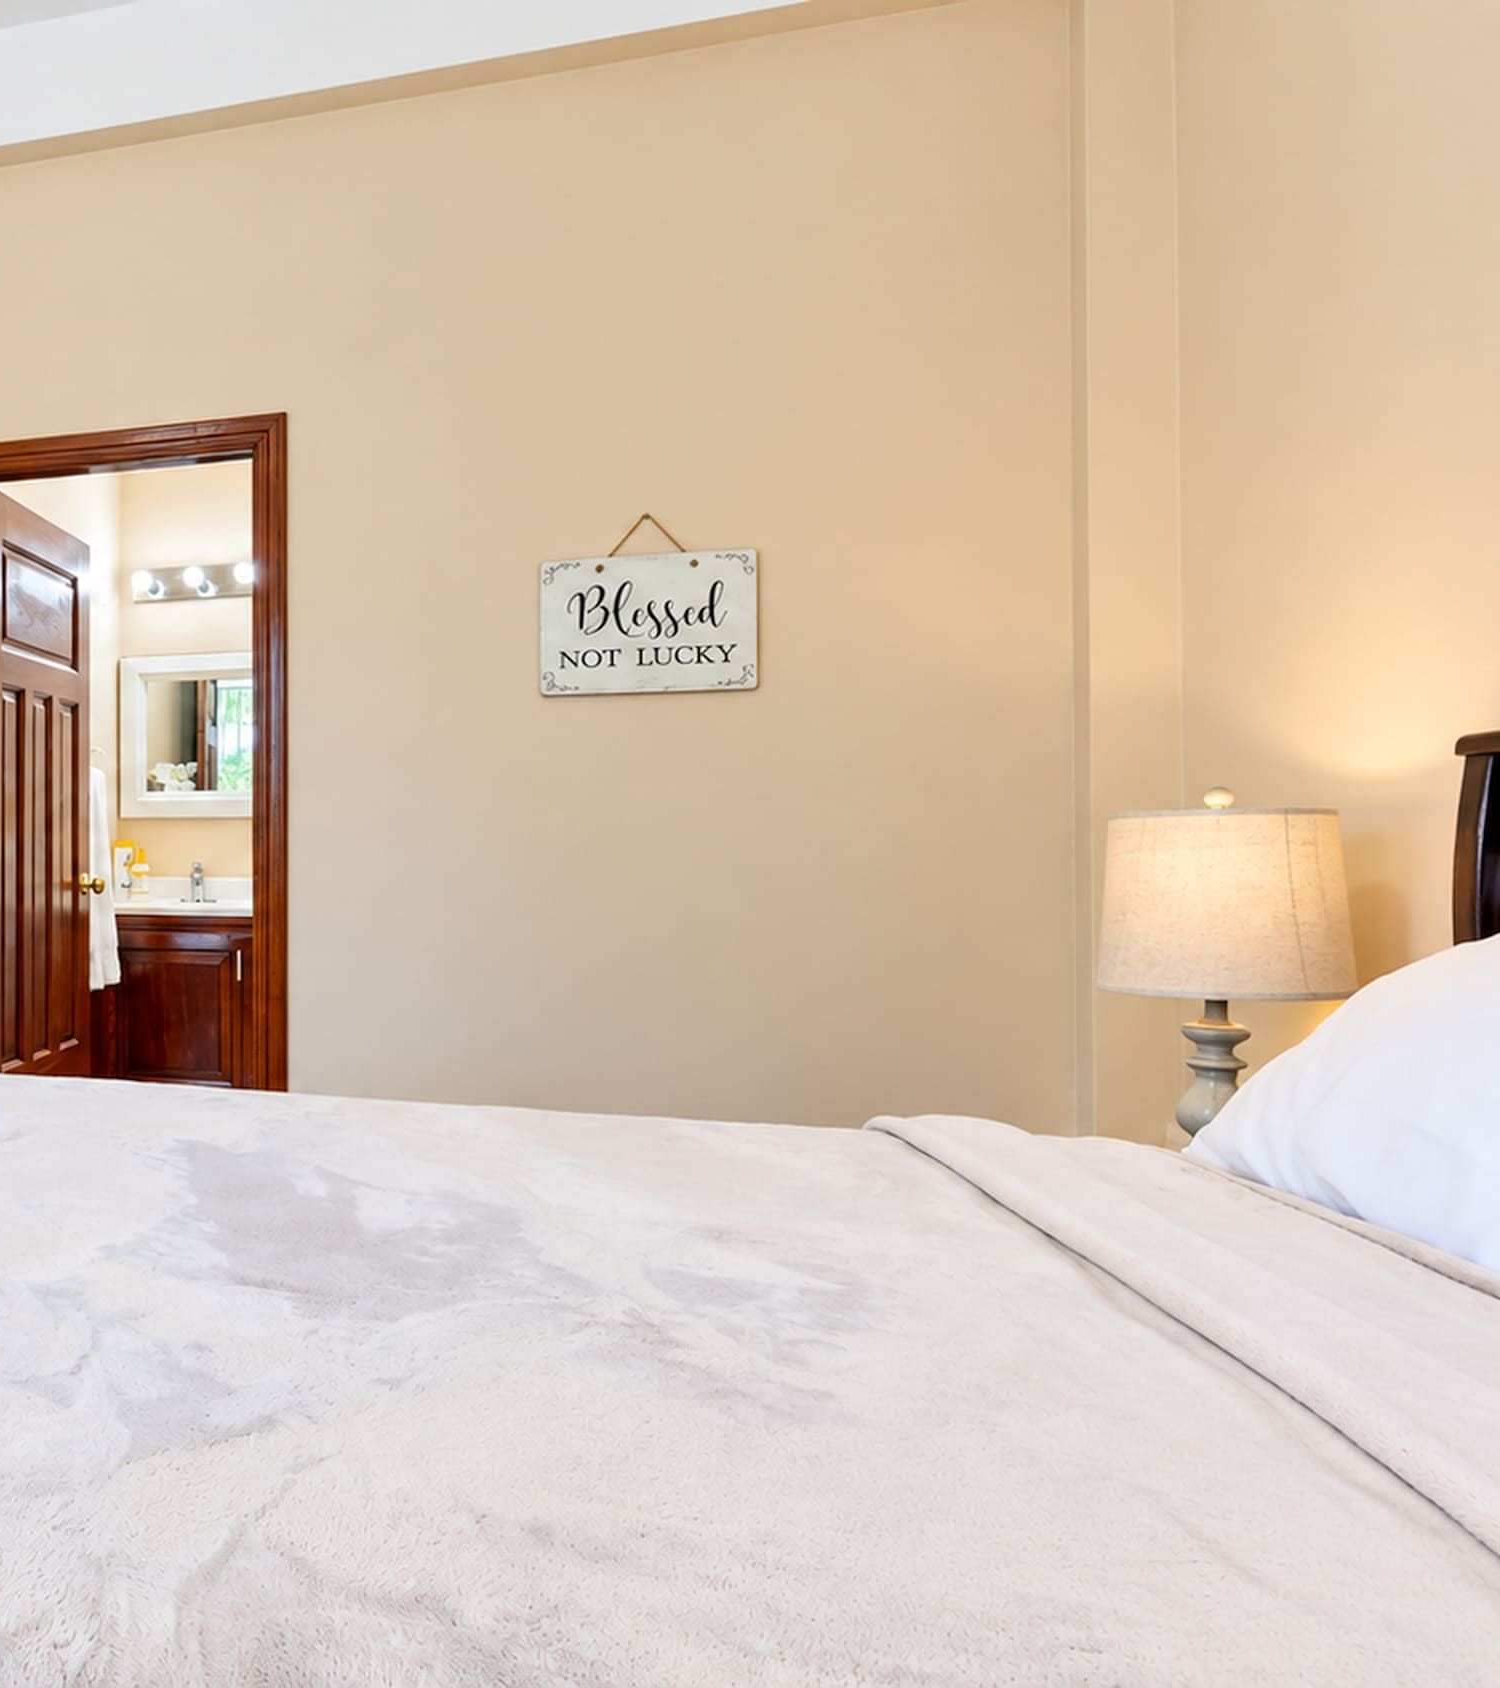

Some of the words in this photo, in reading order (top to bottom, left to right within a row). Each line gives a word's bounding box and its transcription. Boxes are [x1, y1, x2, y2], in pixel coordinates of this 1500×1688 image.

[567, 580, 728, 640] Blessed
[560, 649, 622, 670] NOT
[637, 644, 738, 666] LUCKY
